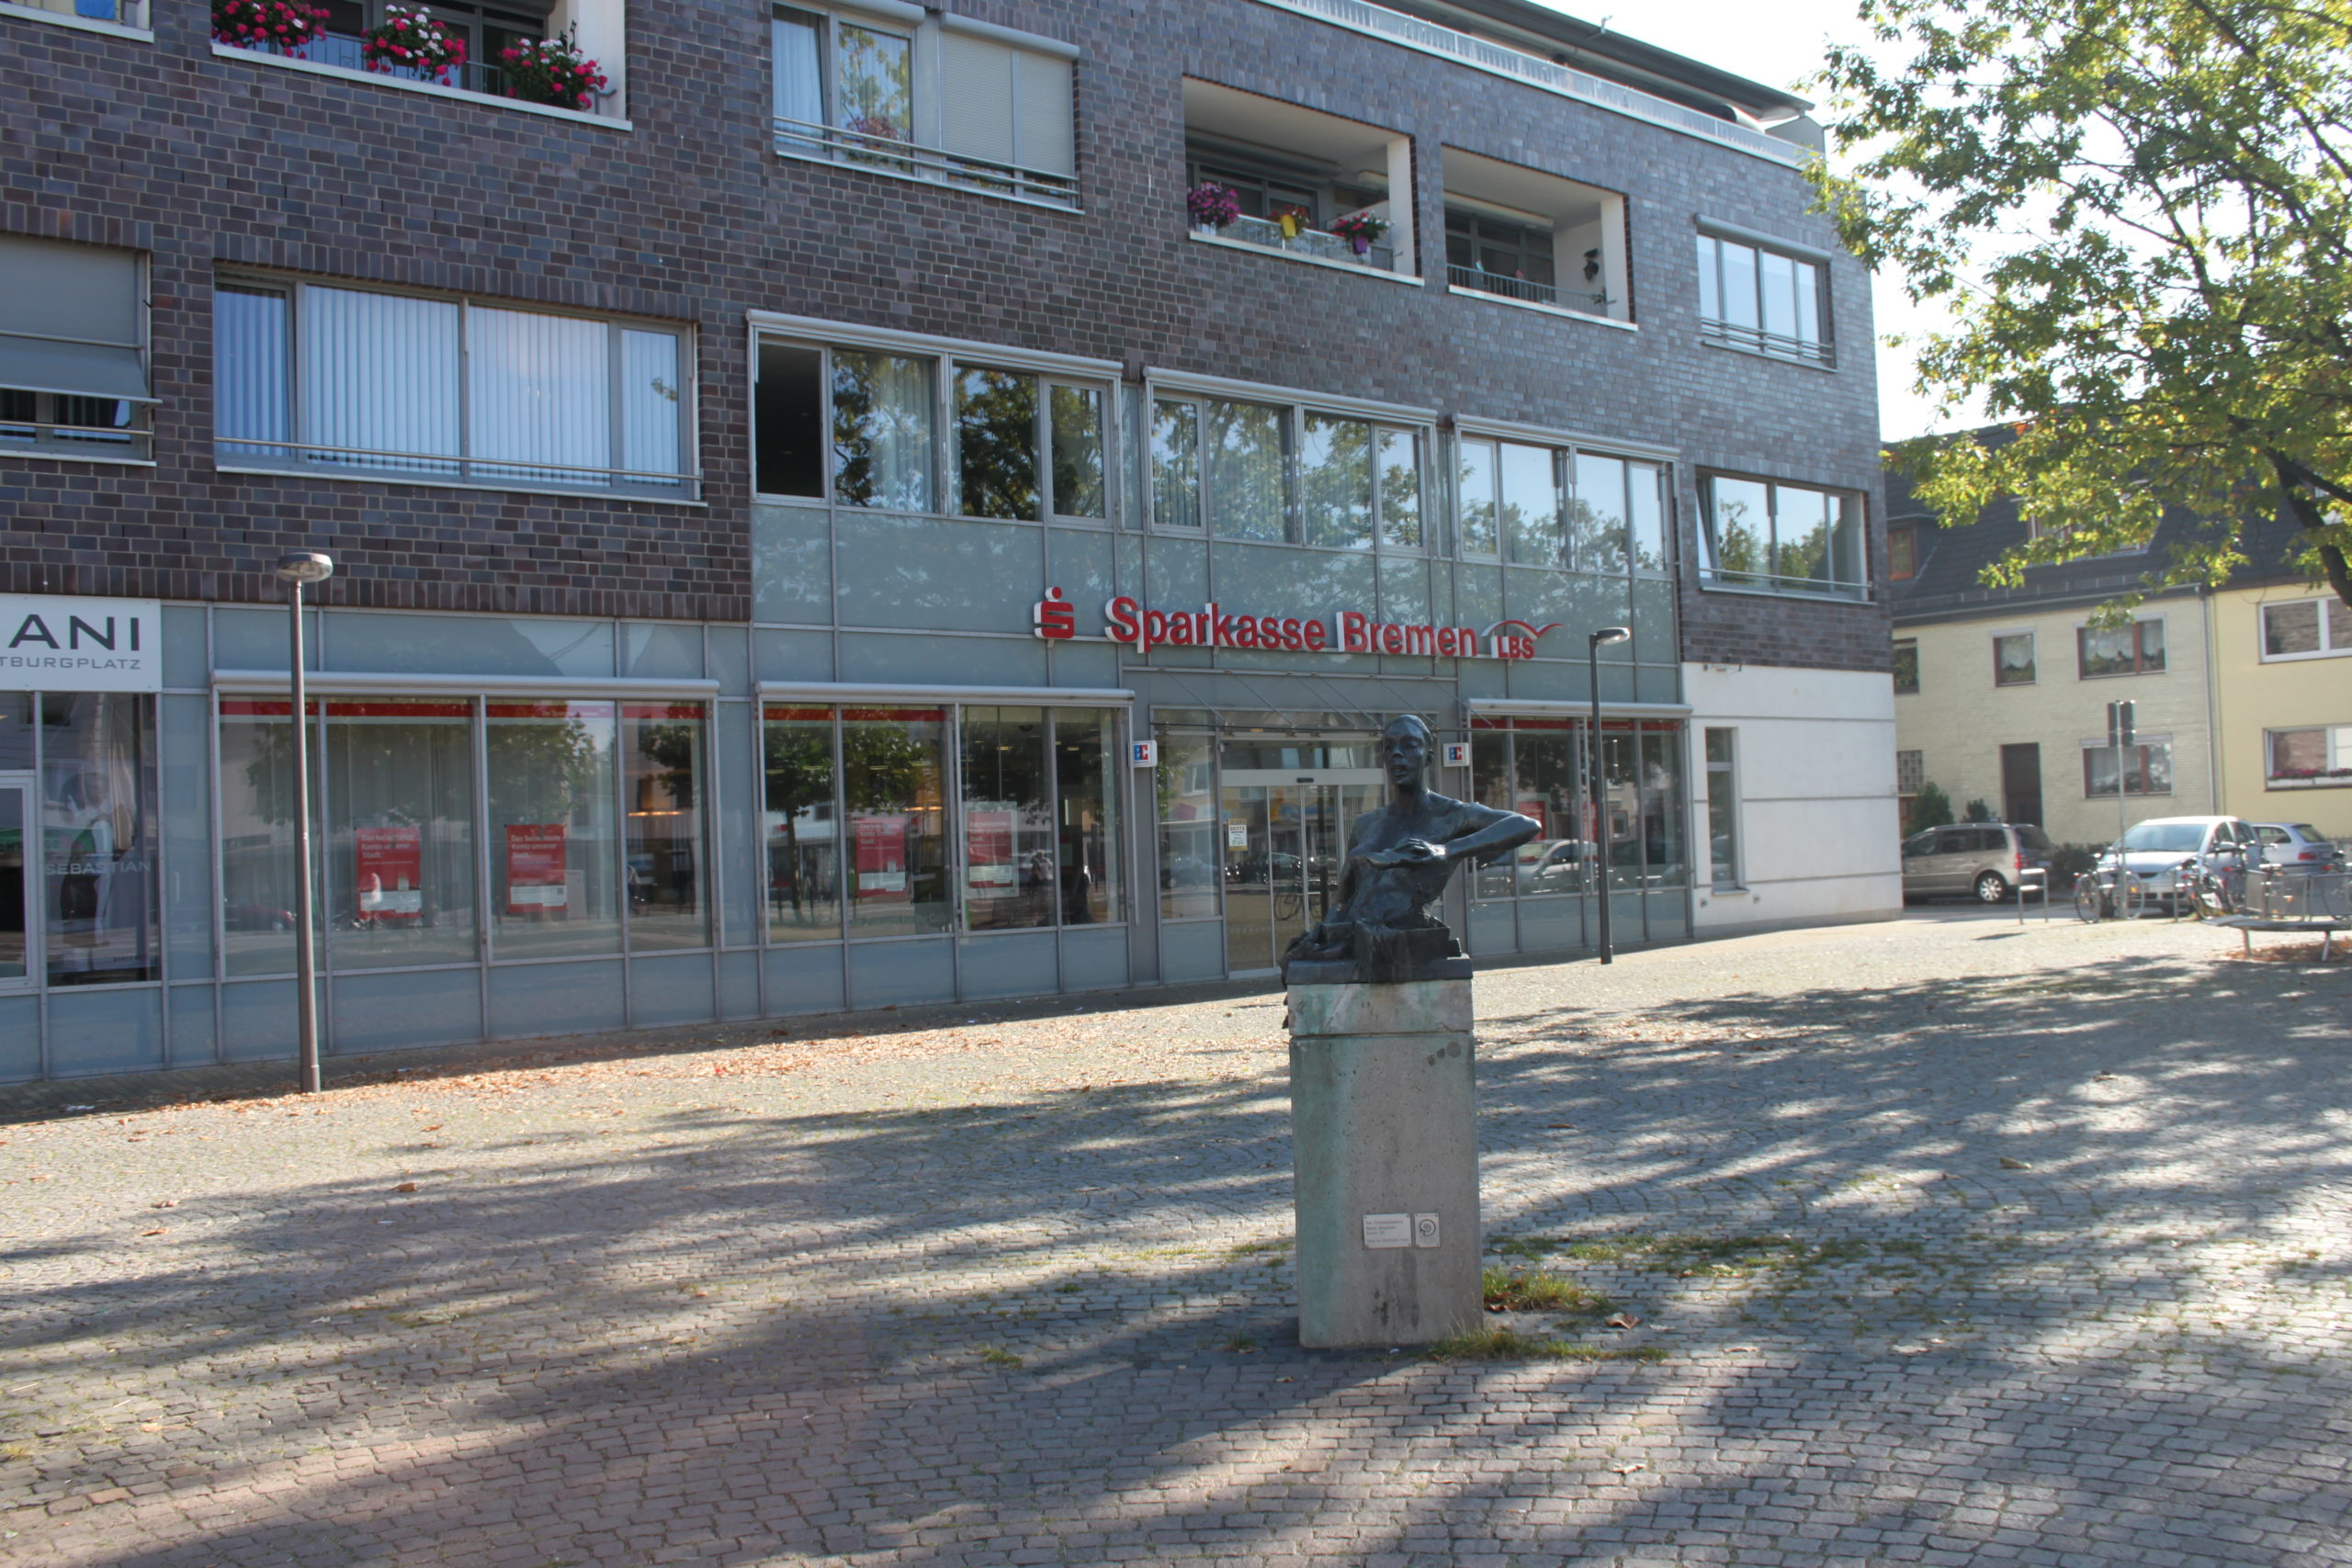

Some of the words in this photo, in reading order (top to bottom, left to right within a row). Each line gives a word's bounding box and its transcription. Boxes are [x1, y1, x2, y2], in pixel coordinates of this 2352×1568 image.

[7, 614, 141, 651] ANI
[1105, 596, 1326, 653] Sparkasse
[1337, 611, 1477, 659] Bremen
[1490, 635, 1535, 660] LBS
[45, 860, 152, 874] SEBASTIAN
